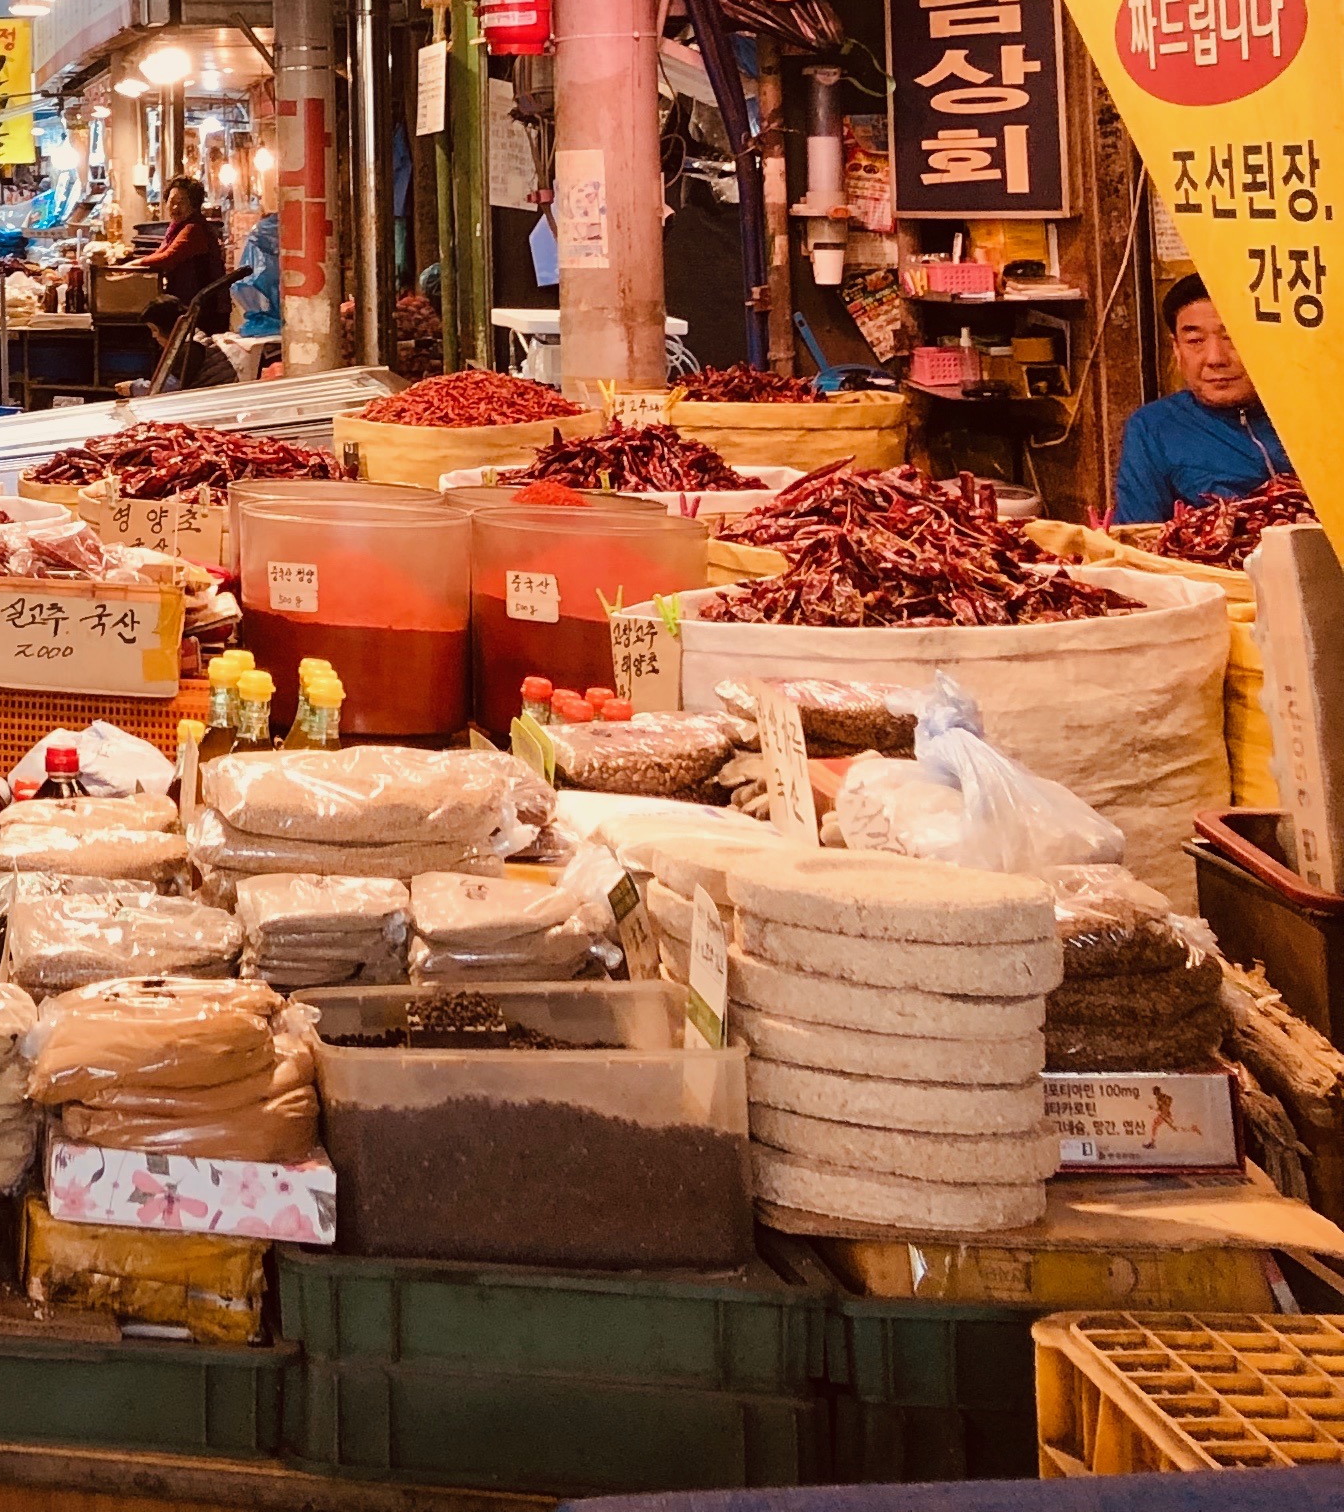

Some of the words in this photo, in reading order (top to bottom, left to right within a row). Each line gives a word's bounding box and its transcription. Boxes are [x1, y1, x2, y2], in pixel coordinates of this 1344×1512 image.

[1246, 245, 1327, 328] 간장
[511, 574, 550, 595] 중국산
[79, 603, 141, 645] 국산
